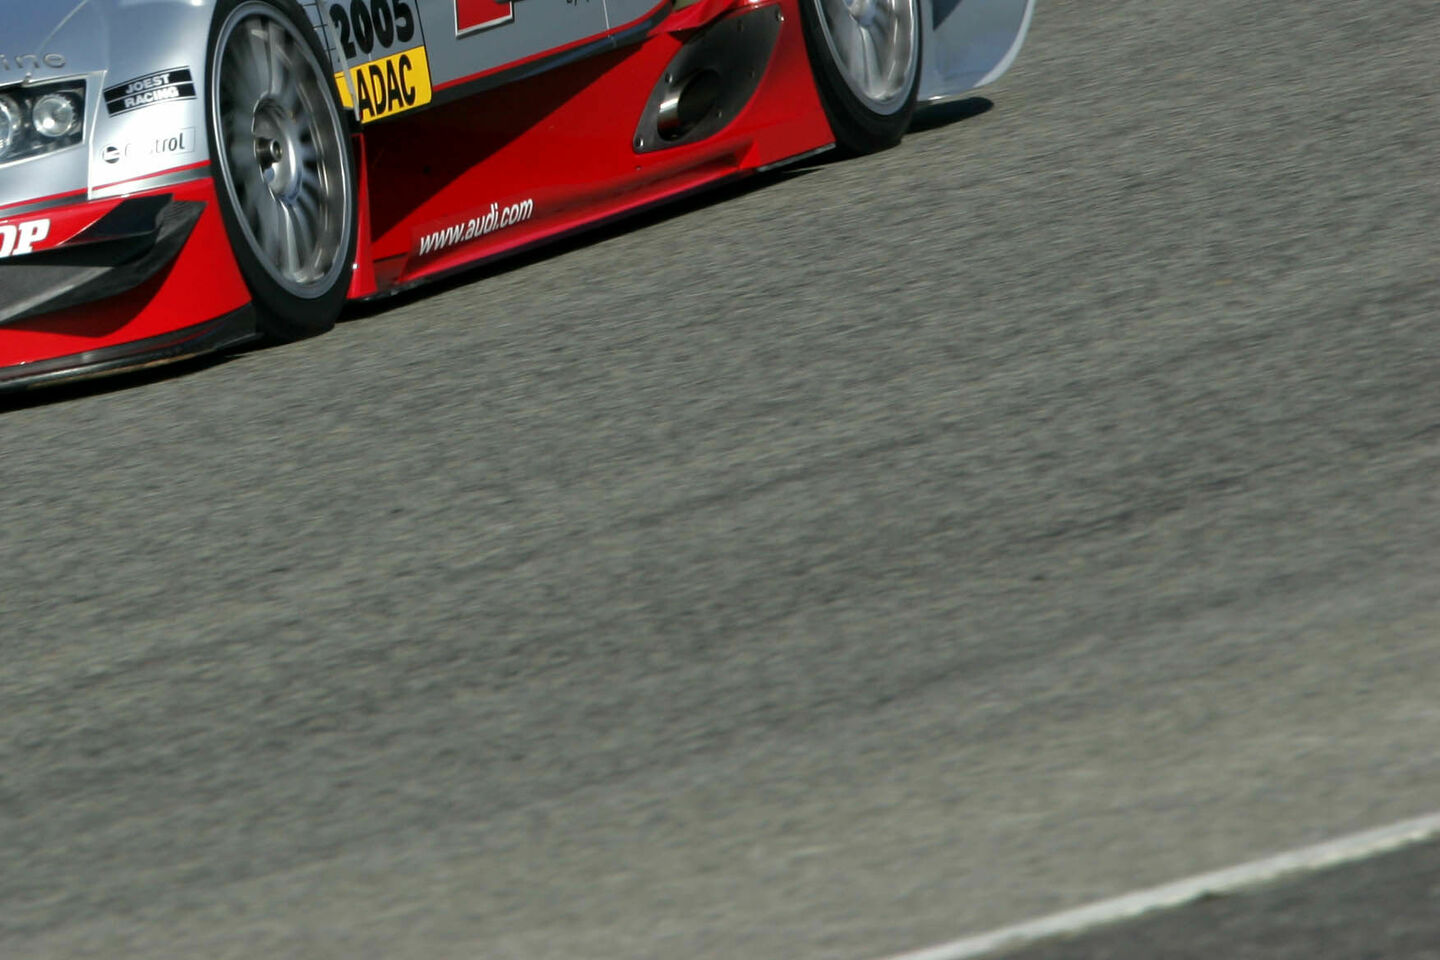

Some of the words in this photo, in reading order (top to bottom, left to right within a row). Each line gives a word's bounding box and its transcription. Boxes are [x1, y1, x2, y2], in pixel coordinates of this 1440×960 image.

[124, 86, 180, 108] RACING
[125, 73, 171, 95] JOEST
[356, 54, 417, 120] ADAC
[419, 197, 533, 257] www.audi.com
